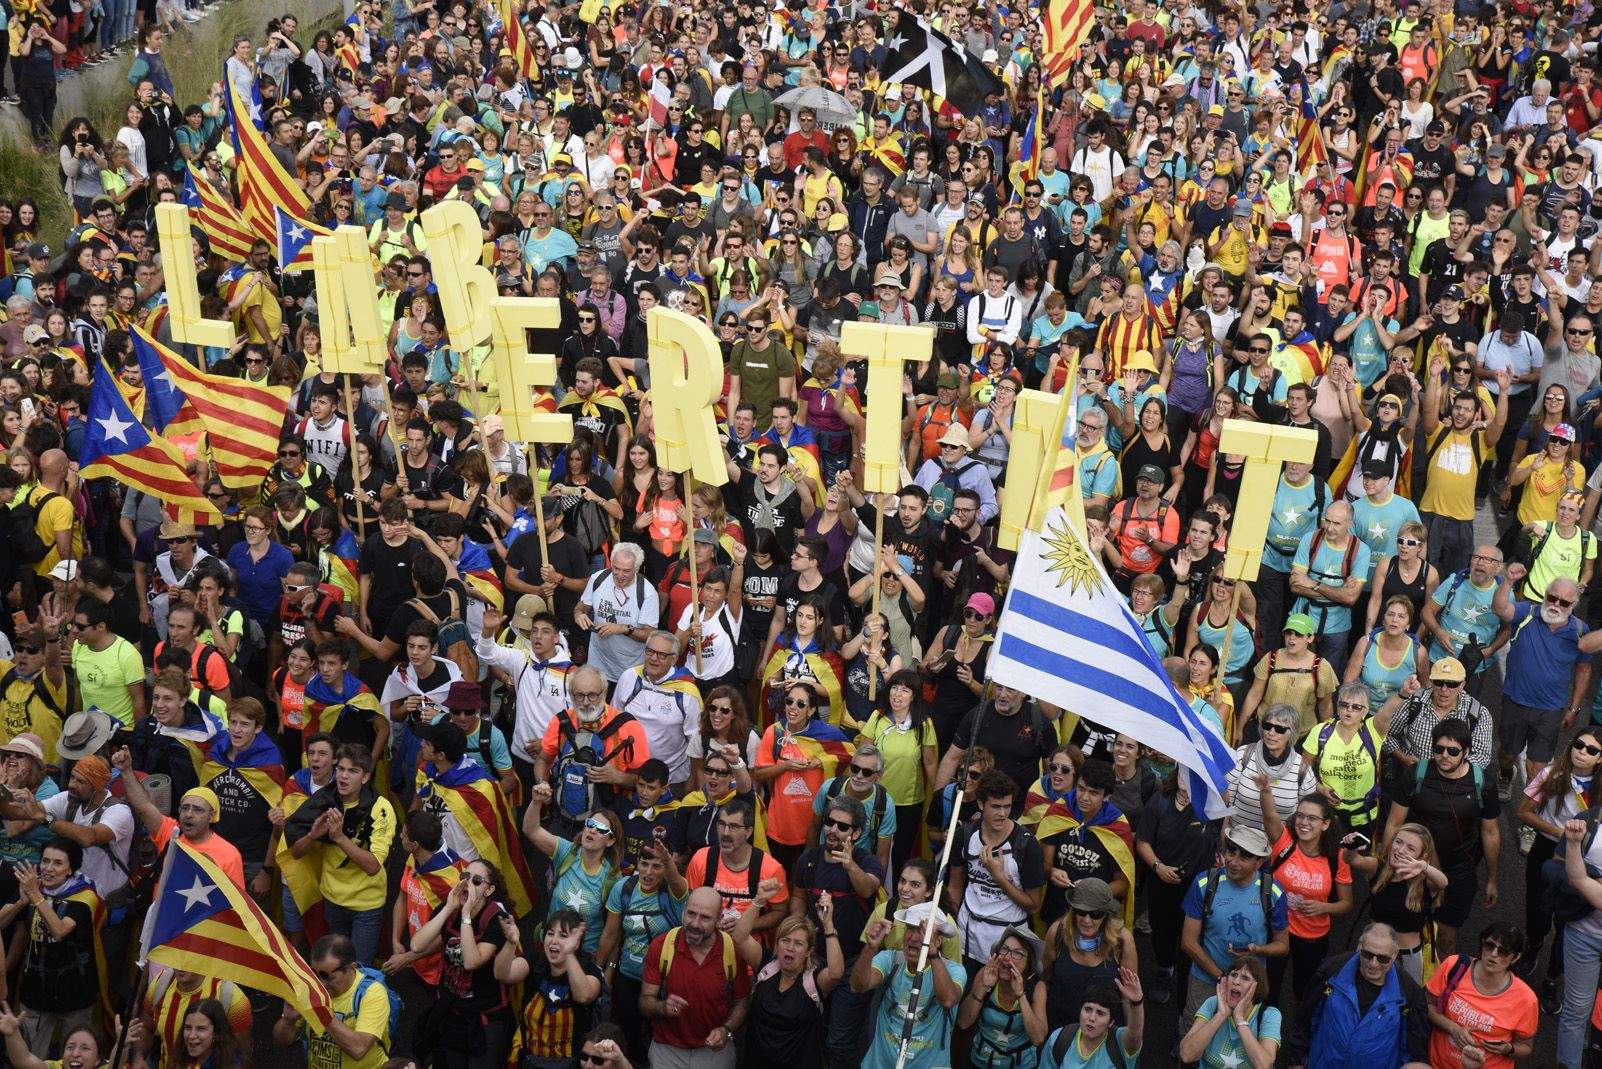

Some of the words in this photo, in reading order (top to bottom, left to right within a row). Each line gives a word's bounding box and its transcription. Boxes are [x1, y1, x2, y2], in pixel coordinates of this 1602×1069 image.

[1034, 226, 1047, 240] NY
[1444, 263, 1457, 276] 21
[223, 787, 239, 797] AND
[1448, 1000, 1495, 1027] REPÚBLICA
